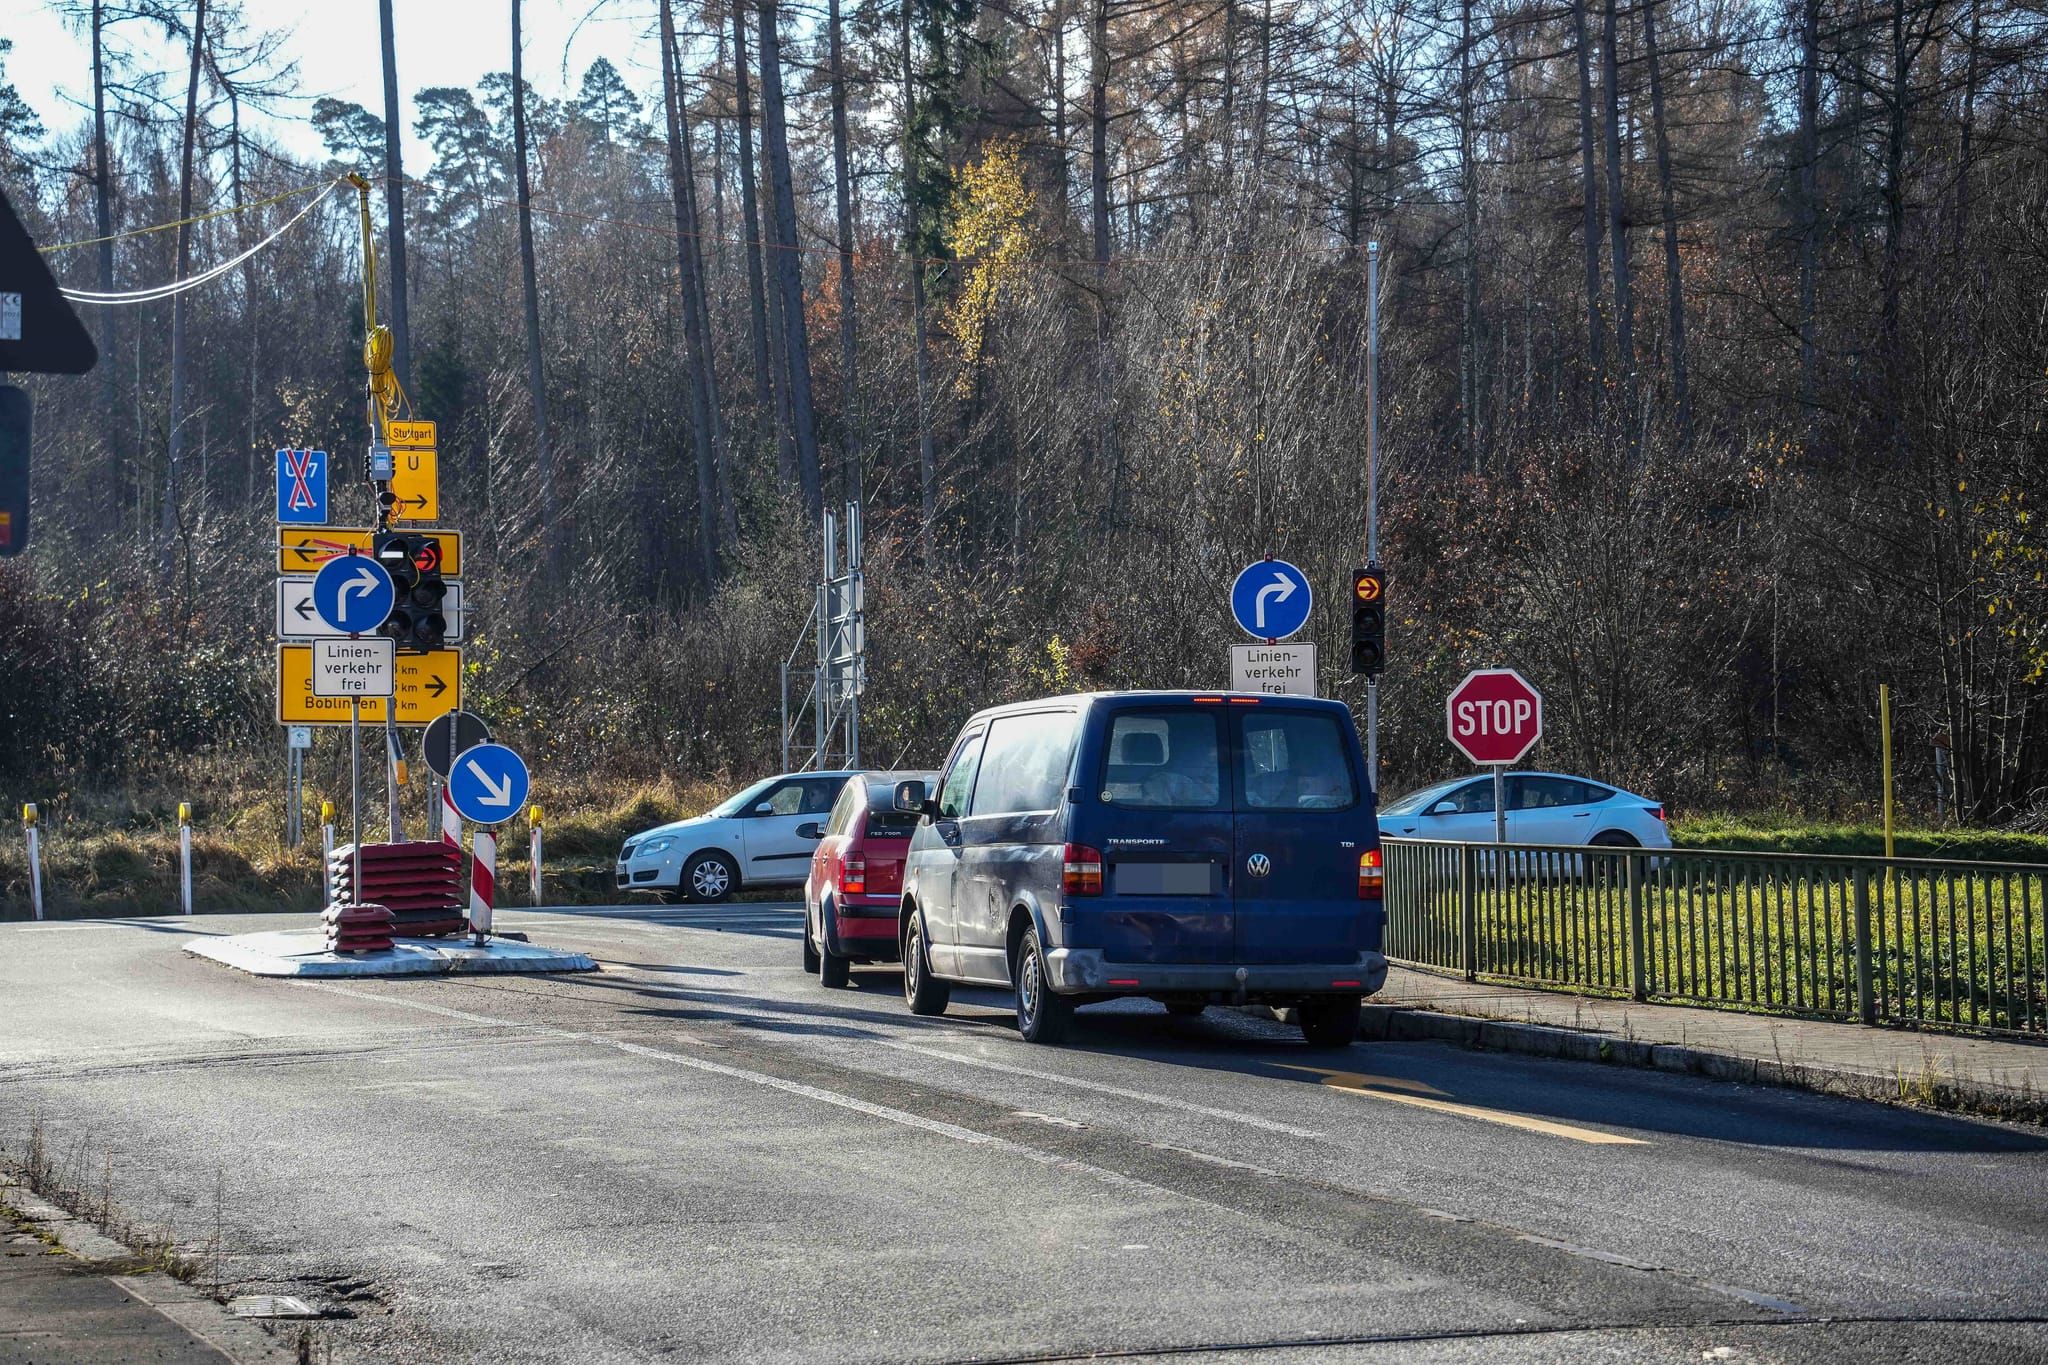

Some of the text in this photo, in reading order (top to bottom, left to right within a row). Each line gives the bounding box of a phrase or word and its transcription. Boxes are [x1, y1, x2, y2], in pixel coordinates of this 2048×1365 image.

[393, 427, 432, 441] Stuttgart
[408, 456, 419, 471] U
[327, 645, 379, 658] Linien-
[1247, 650, 1298, 662] Linien-
[324, 661, 382, 674] verkehr
[401, 665, 418, 675] km
[1245, 665, 1301, 679] verkehr
[342, 677, 366, 690] frei
[401, 683, 418, 692] km
[1261, 681, 1286, 694] frei
[401, 700, 418, 710] km
[1457, 699, 1531, 736] STOP
